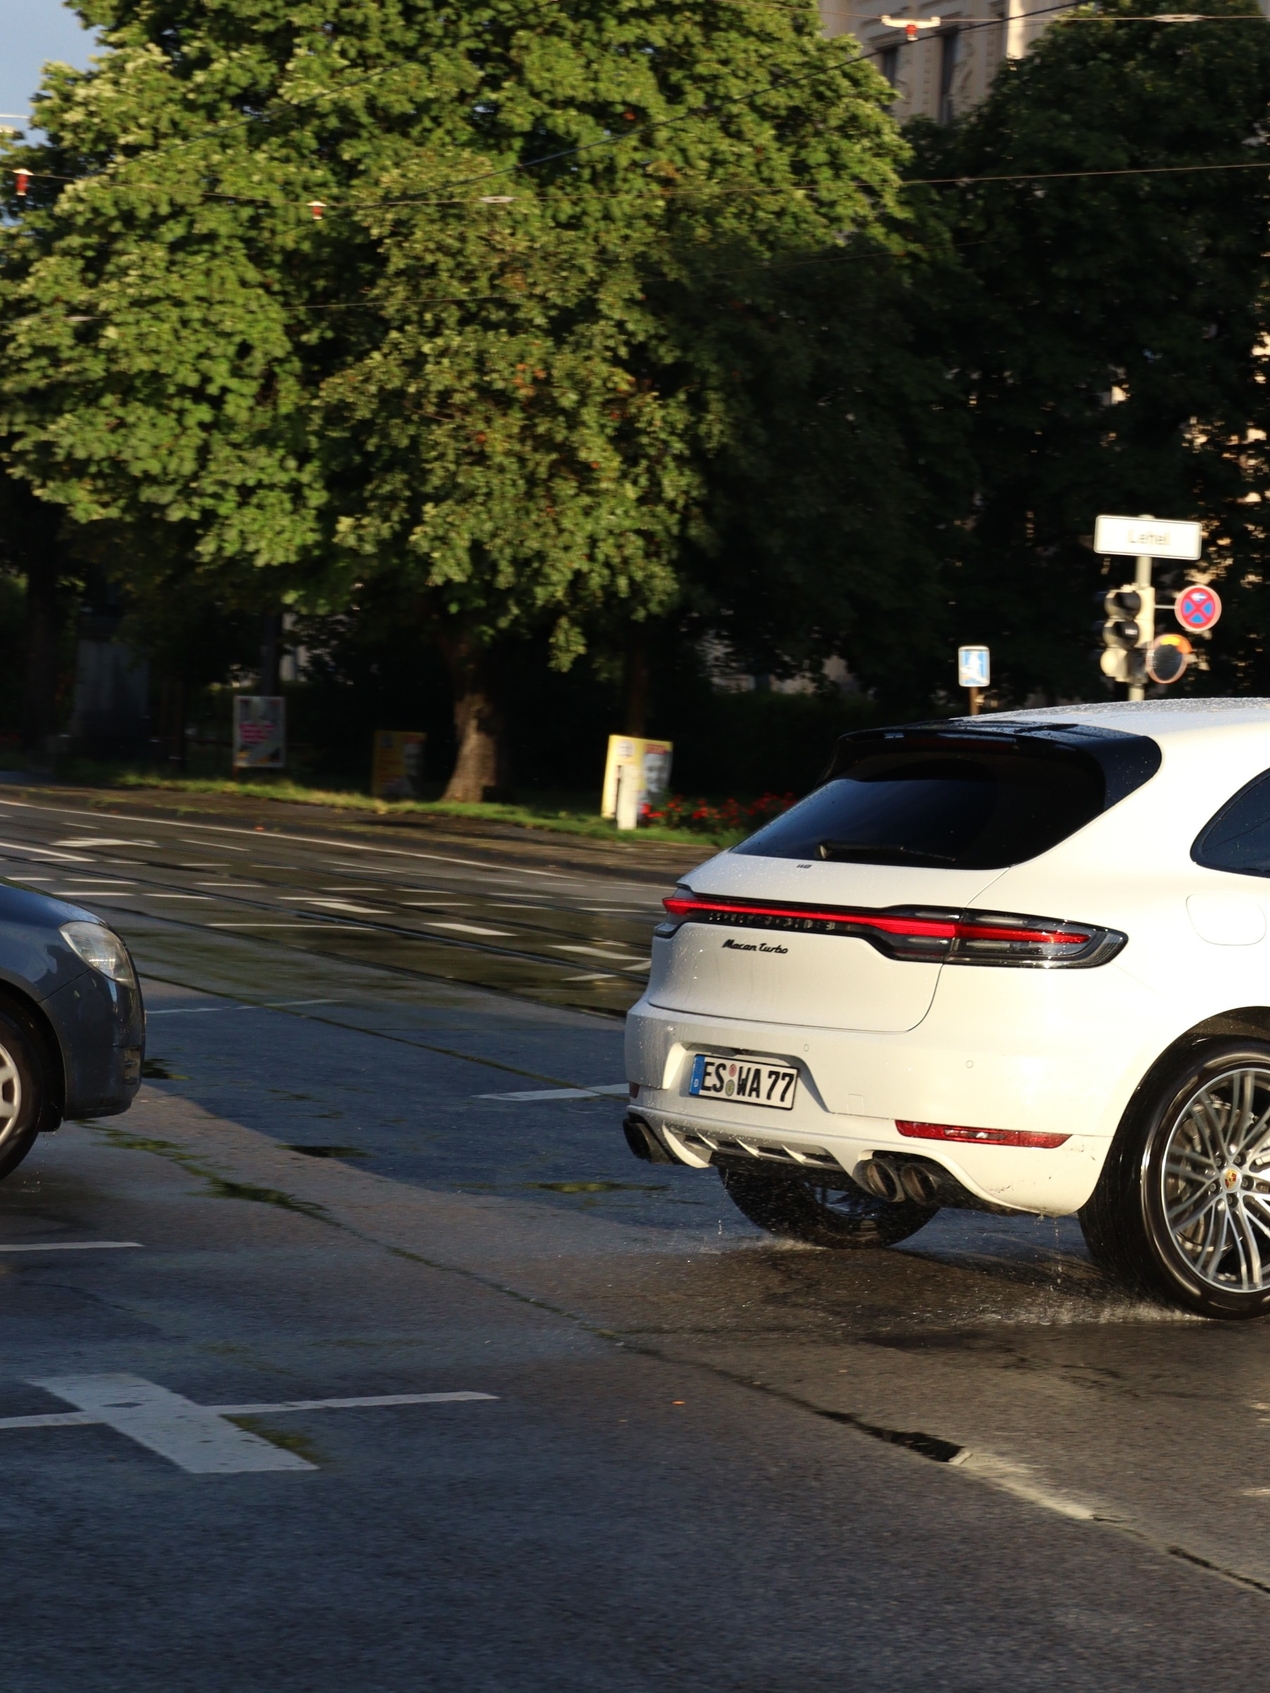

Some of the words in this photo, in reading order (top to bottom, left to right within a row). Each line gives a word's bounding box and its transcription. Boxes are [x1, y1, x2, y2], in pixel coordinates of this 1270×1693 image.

[721, 938, 757, 952] Macan
[701, 1060, 727, 1093] ES
[736, 1065, 762, 1099] WA
[765, 1070, 795, 1103] 77
